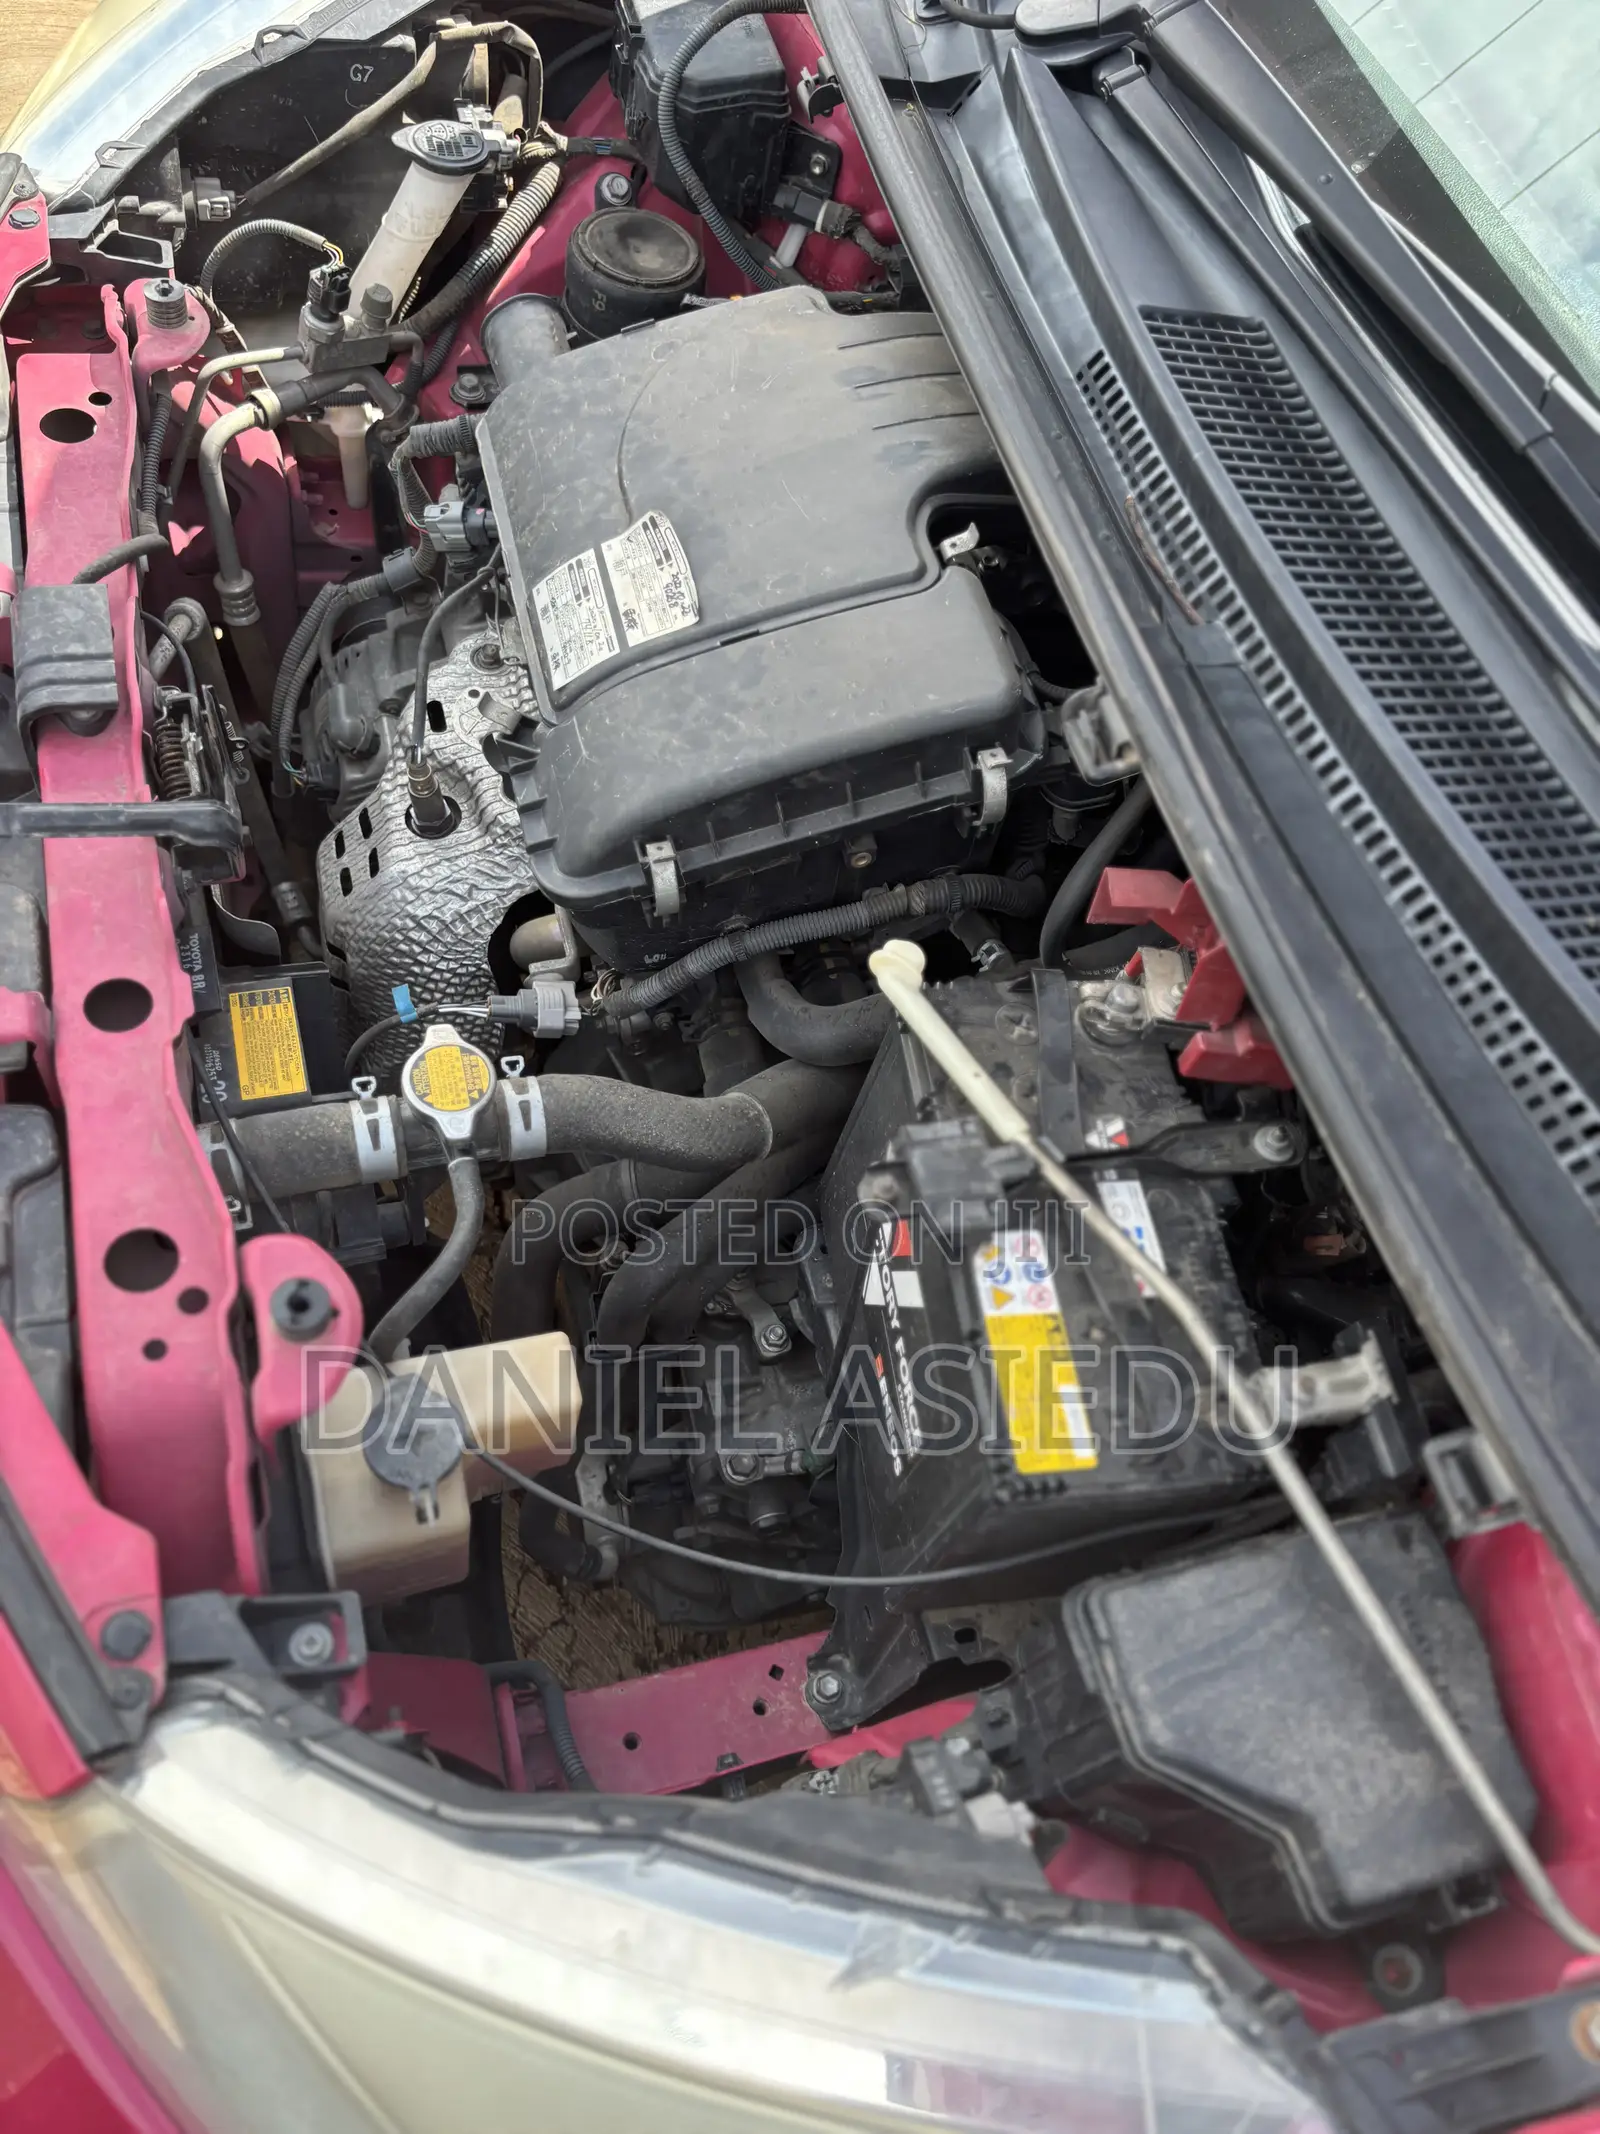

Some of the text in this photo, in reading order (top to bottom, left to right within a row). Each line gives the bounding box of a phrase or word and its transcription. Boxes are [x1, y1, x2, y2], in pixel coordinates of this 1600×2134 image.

[350, 65, 373, 82] G7
[189, 932, 203, 971] TOYOTA
[212, 1049, 222, 1070] DENSO
[411, 1068, 423, 1095] CAUTION
[895, 1336, 923, 1449] FORCE
[878, 1376, 903, 1477] ENEOS
